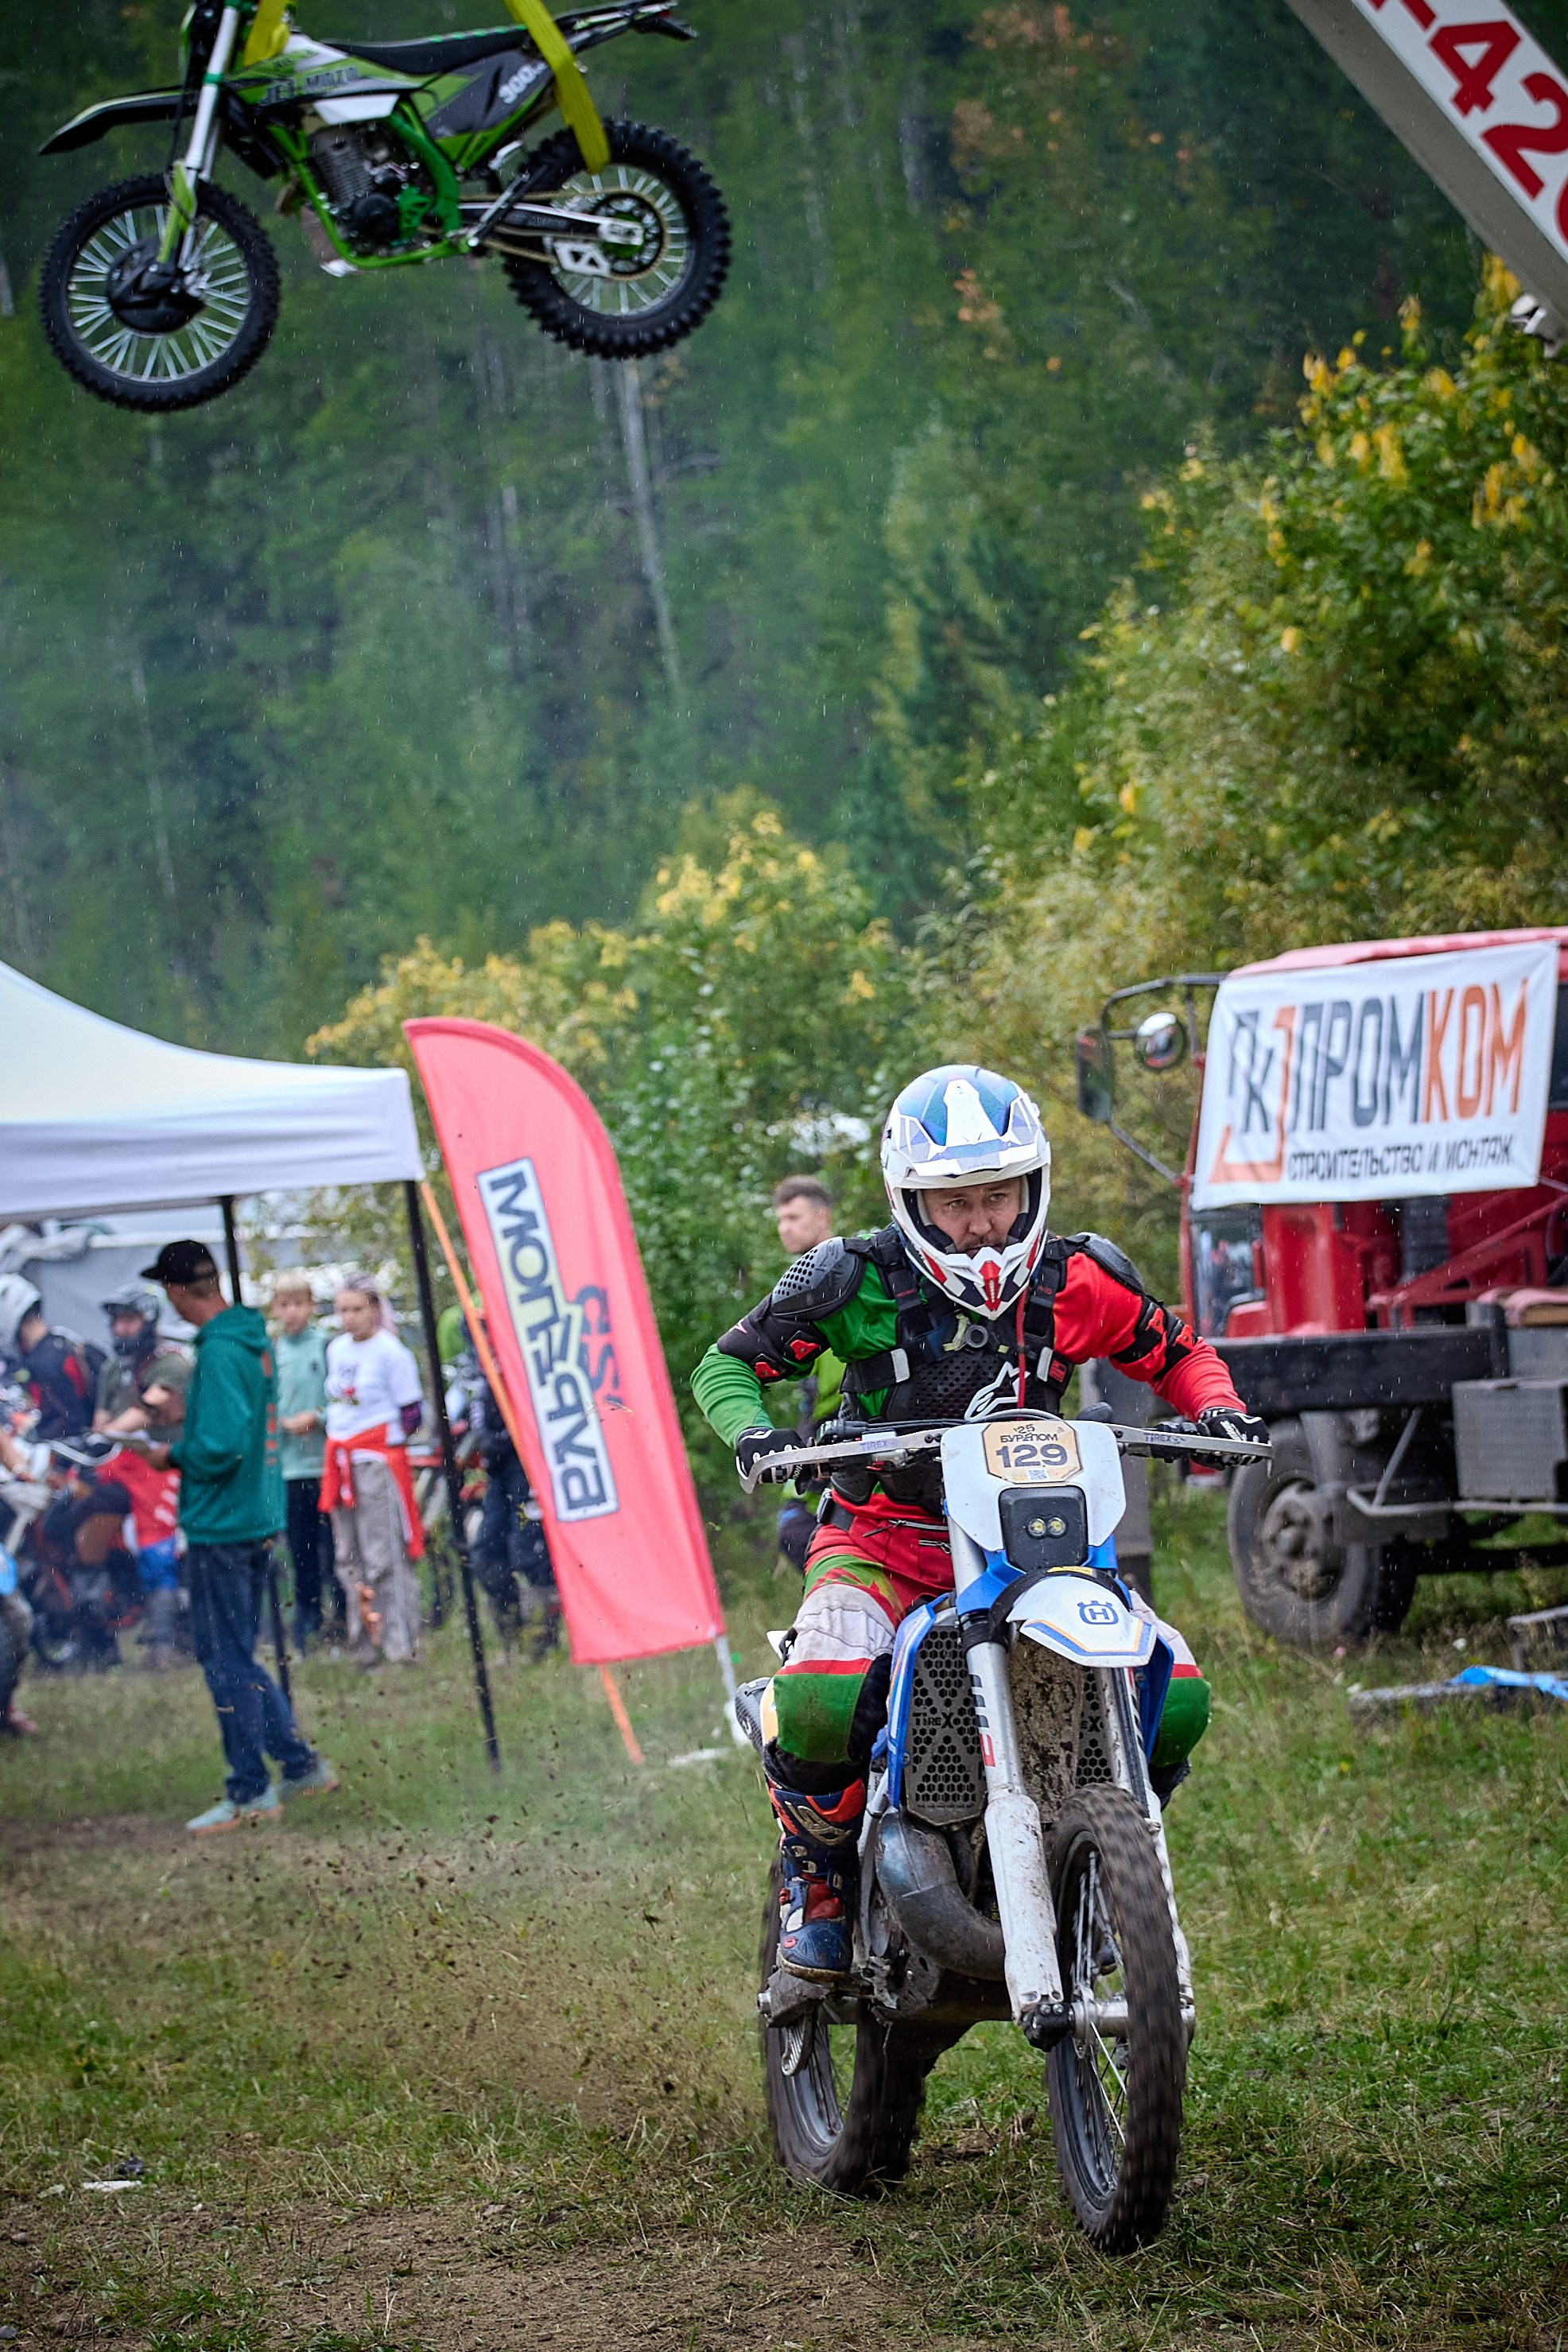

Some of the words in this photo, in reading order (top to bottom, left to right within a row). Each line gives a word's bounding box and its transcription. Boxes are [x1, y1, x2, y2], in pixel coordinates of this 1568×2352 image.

[1366, 0, 1568, 246] -42
[1290, 978, 1529, 1134] ПРОМКОМ
[996, 1443, 1068, 1468] 129
